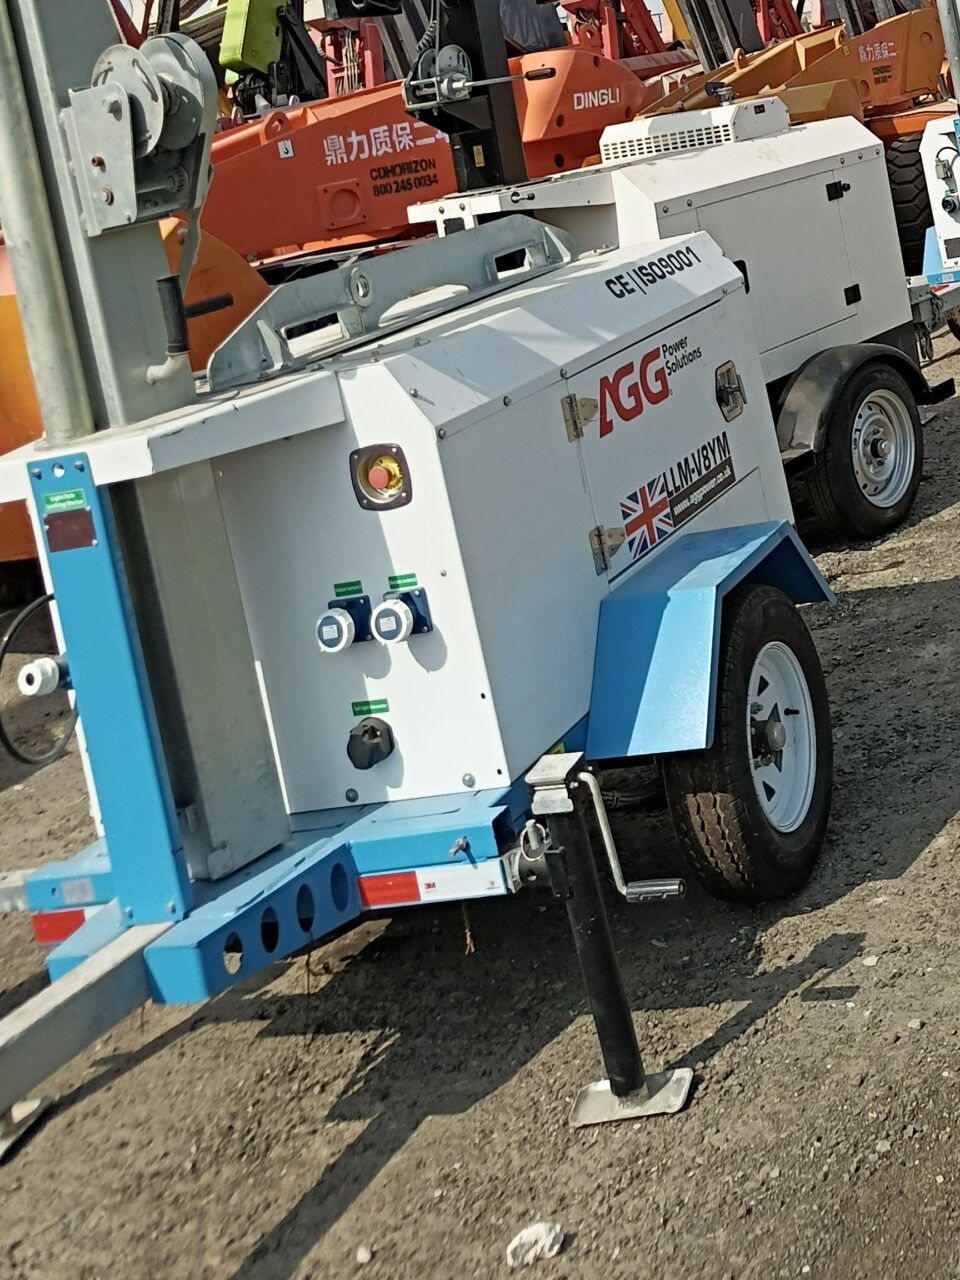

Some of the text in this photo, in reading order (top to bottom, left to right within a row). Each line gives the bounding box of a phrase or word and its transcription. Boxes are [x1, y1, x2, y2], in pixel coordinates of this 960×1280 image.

[573, 88, 620, 110] DINGLI
[323, 122, 450, 166] 鼎力质保二
[662, 336, 688, 359] Power
[665, 347, 702, 376] Solutions
[599, 347, 670, 439] AGG
[663, 431, 731, 498] LLM-V8YM
